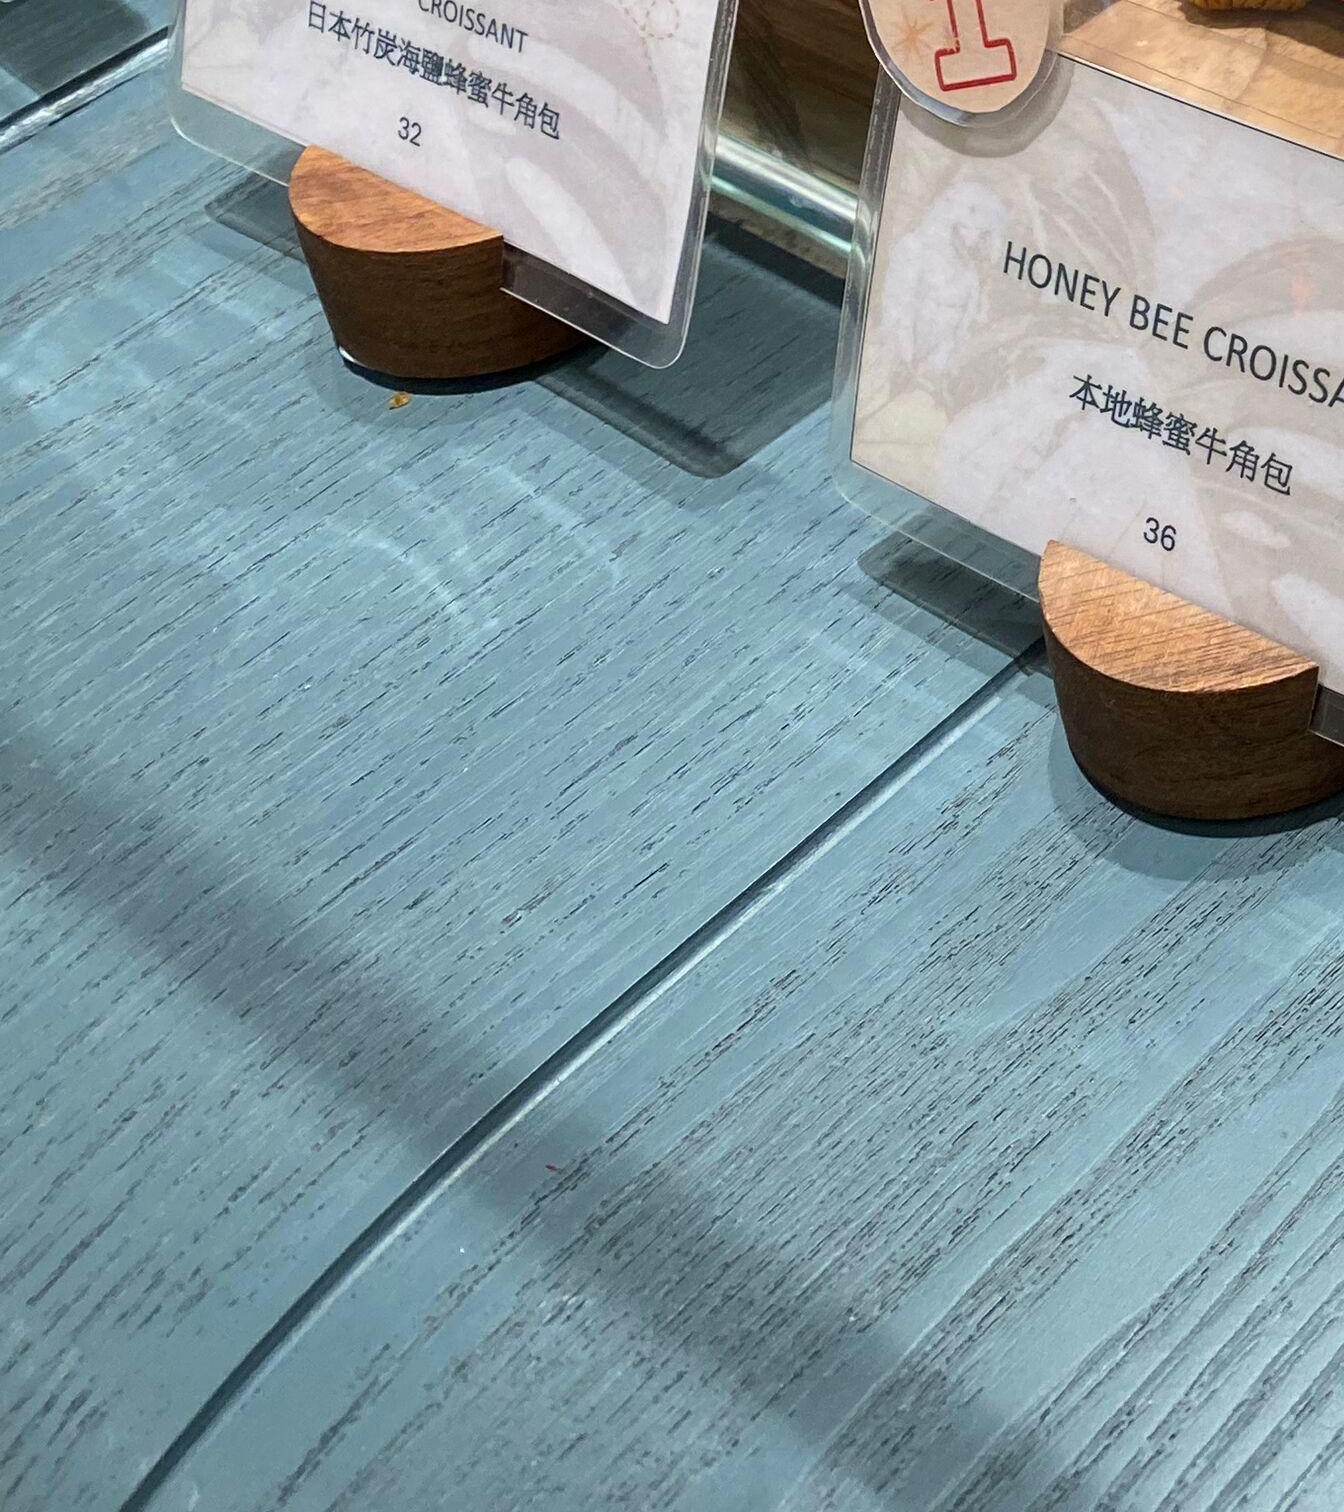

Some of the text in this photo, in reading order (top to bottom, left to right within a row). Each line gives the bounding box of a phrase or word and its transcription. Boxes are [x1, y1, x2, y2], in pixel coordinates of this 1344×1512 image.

[396, 116, 423, 147] 32
[1003, 240, 1122, 319] HONEY
[1129, 293, 1194, 351] BEE
[1068, 373, 1295, 498] 本地蜂蜜牛角包
[1142, 516, 1178, 553] 36
